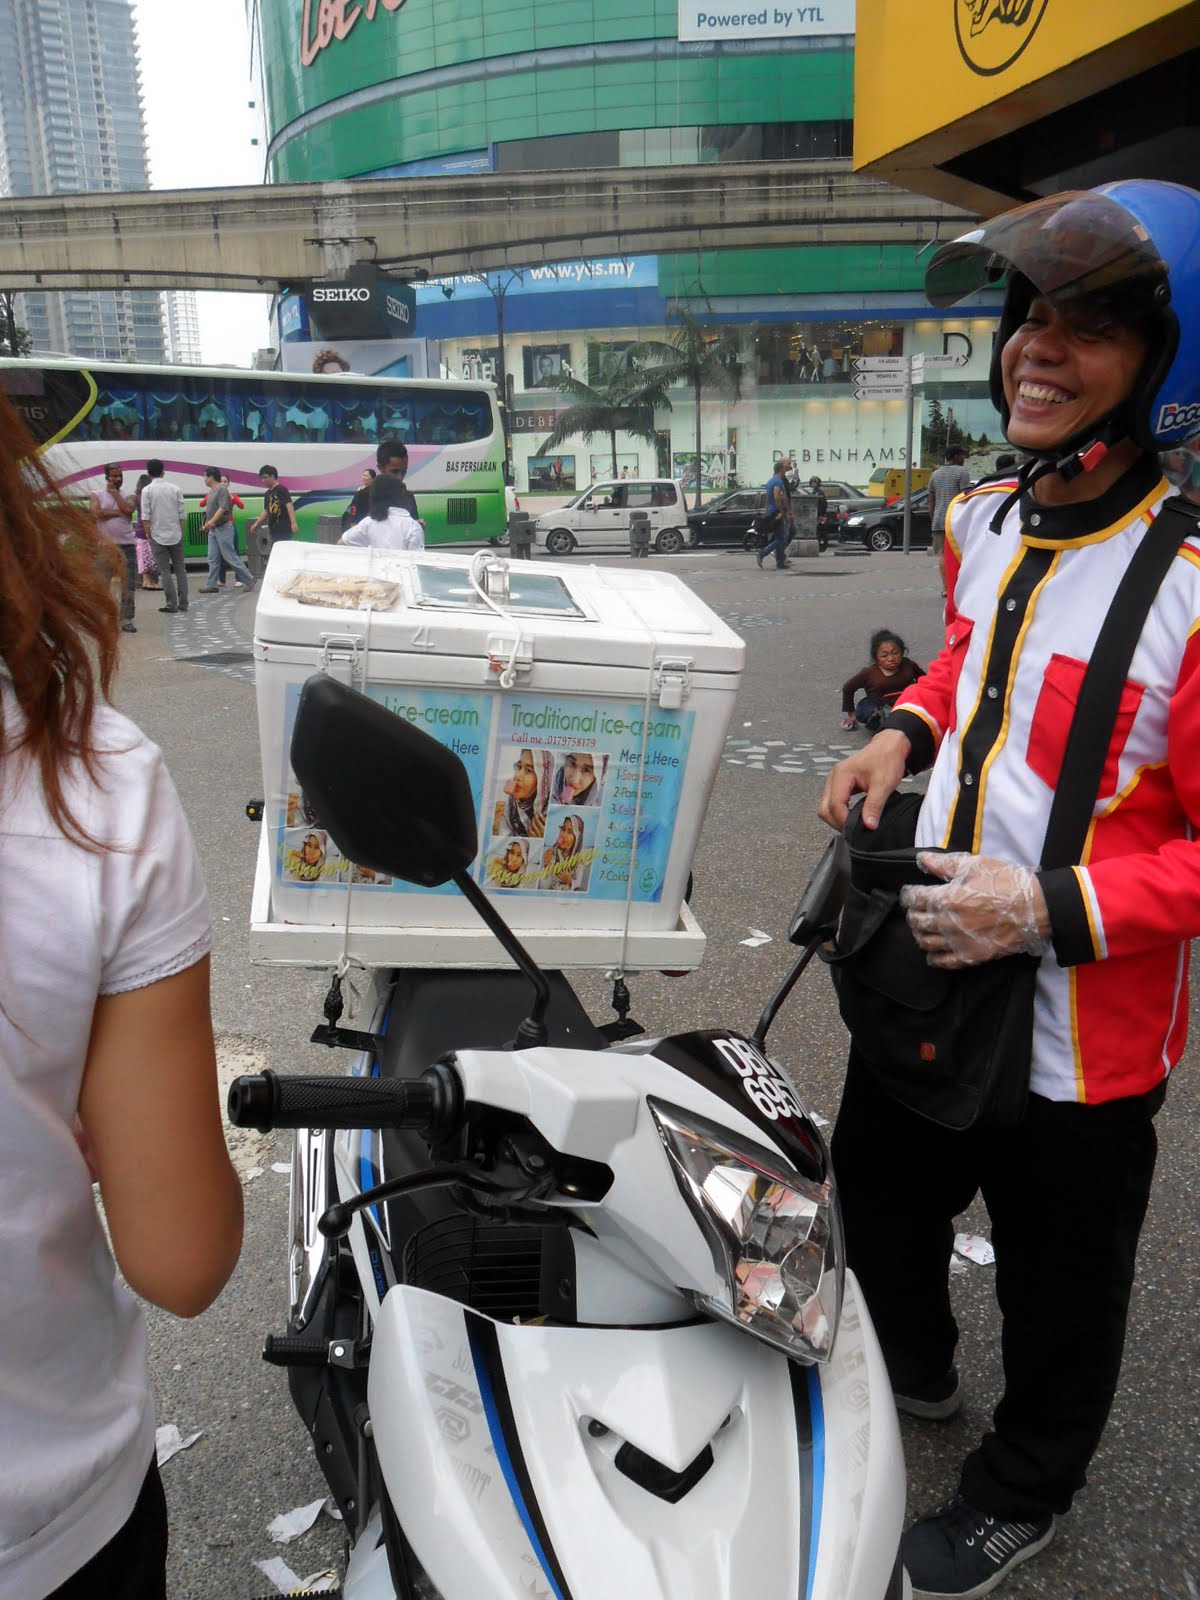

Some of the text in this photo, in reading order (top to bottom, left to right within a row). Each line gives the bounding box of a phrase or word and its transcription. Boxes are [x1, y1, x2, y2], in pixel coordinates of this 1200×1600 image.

[697, 7, 824, 28] Powered by YTL
[530, 261, 635, 281] www.yes.my
[312, 288, 370, 302] SEIKO
[386, 294, 410, 324] SEIKO
[772, 446, 907, 463] DEBENHAMS
[446, 461, 498, 473] BAS PERSIARAN
[393, 697, 479, 727] ice-cream
[512, 703, 681, 741] Traditional ice-cream
[451, 738, 480, 755] Here
[512, 732, 529, 744] Call
[530, 736, 543, 745] me
[653, 750, 680, 768] Here
[616, 768, 664, 786] 1-Straberry
[613, 786, 653, 800] 2-Panan
